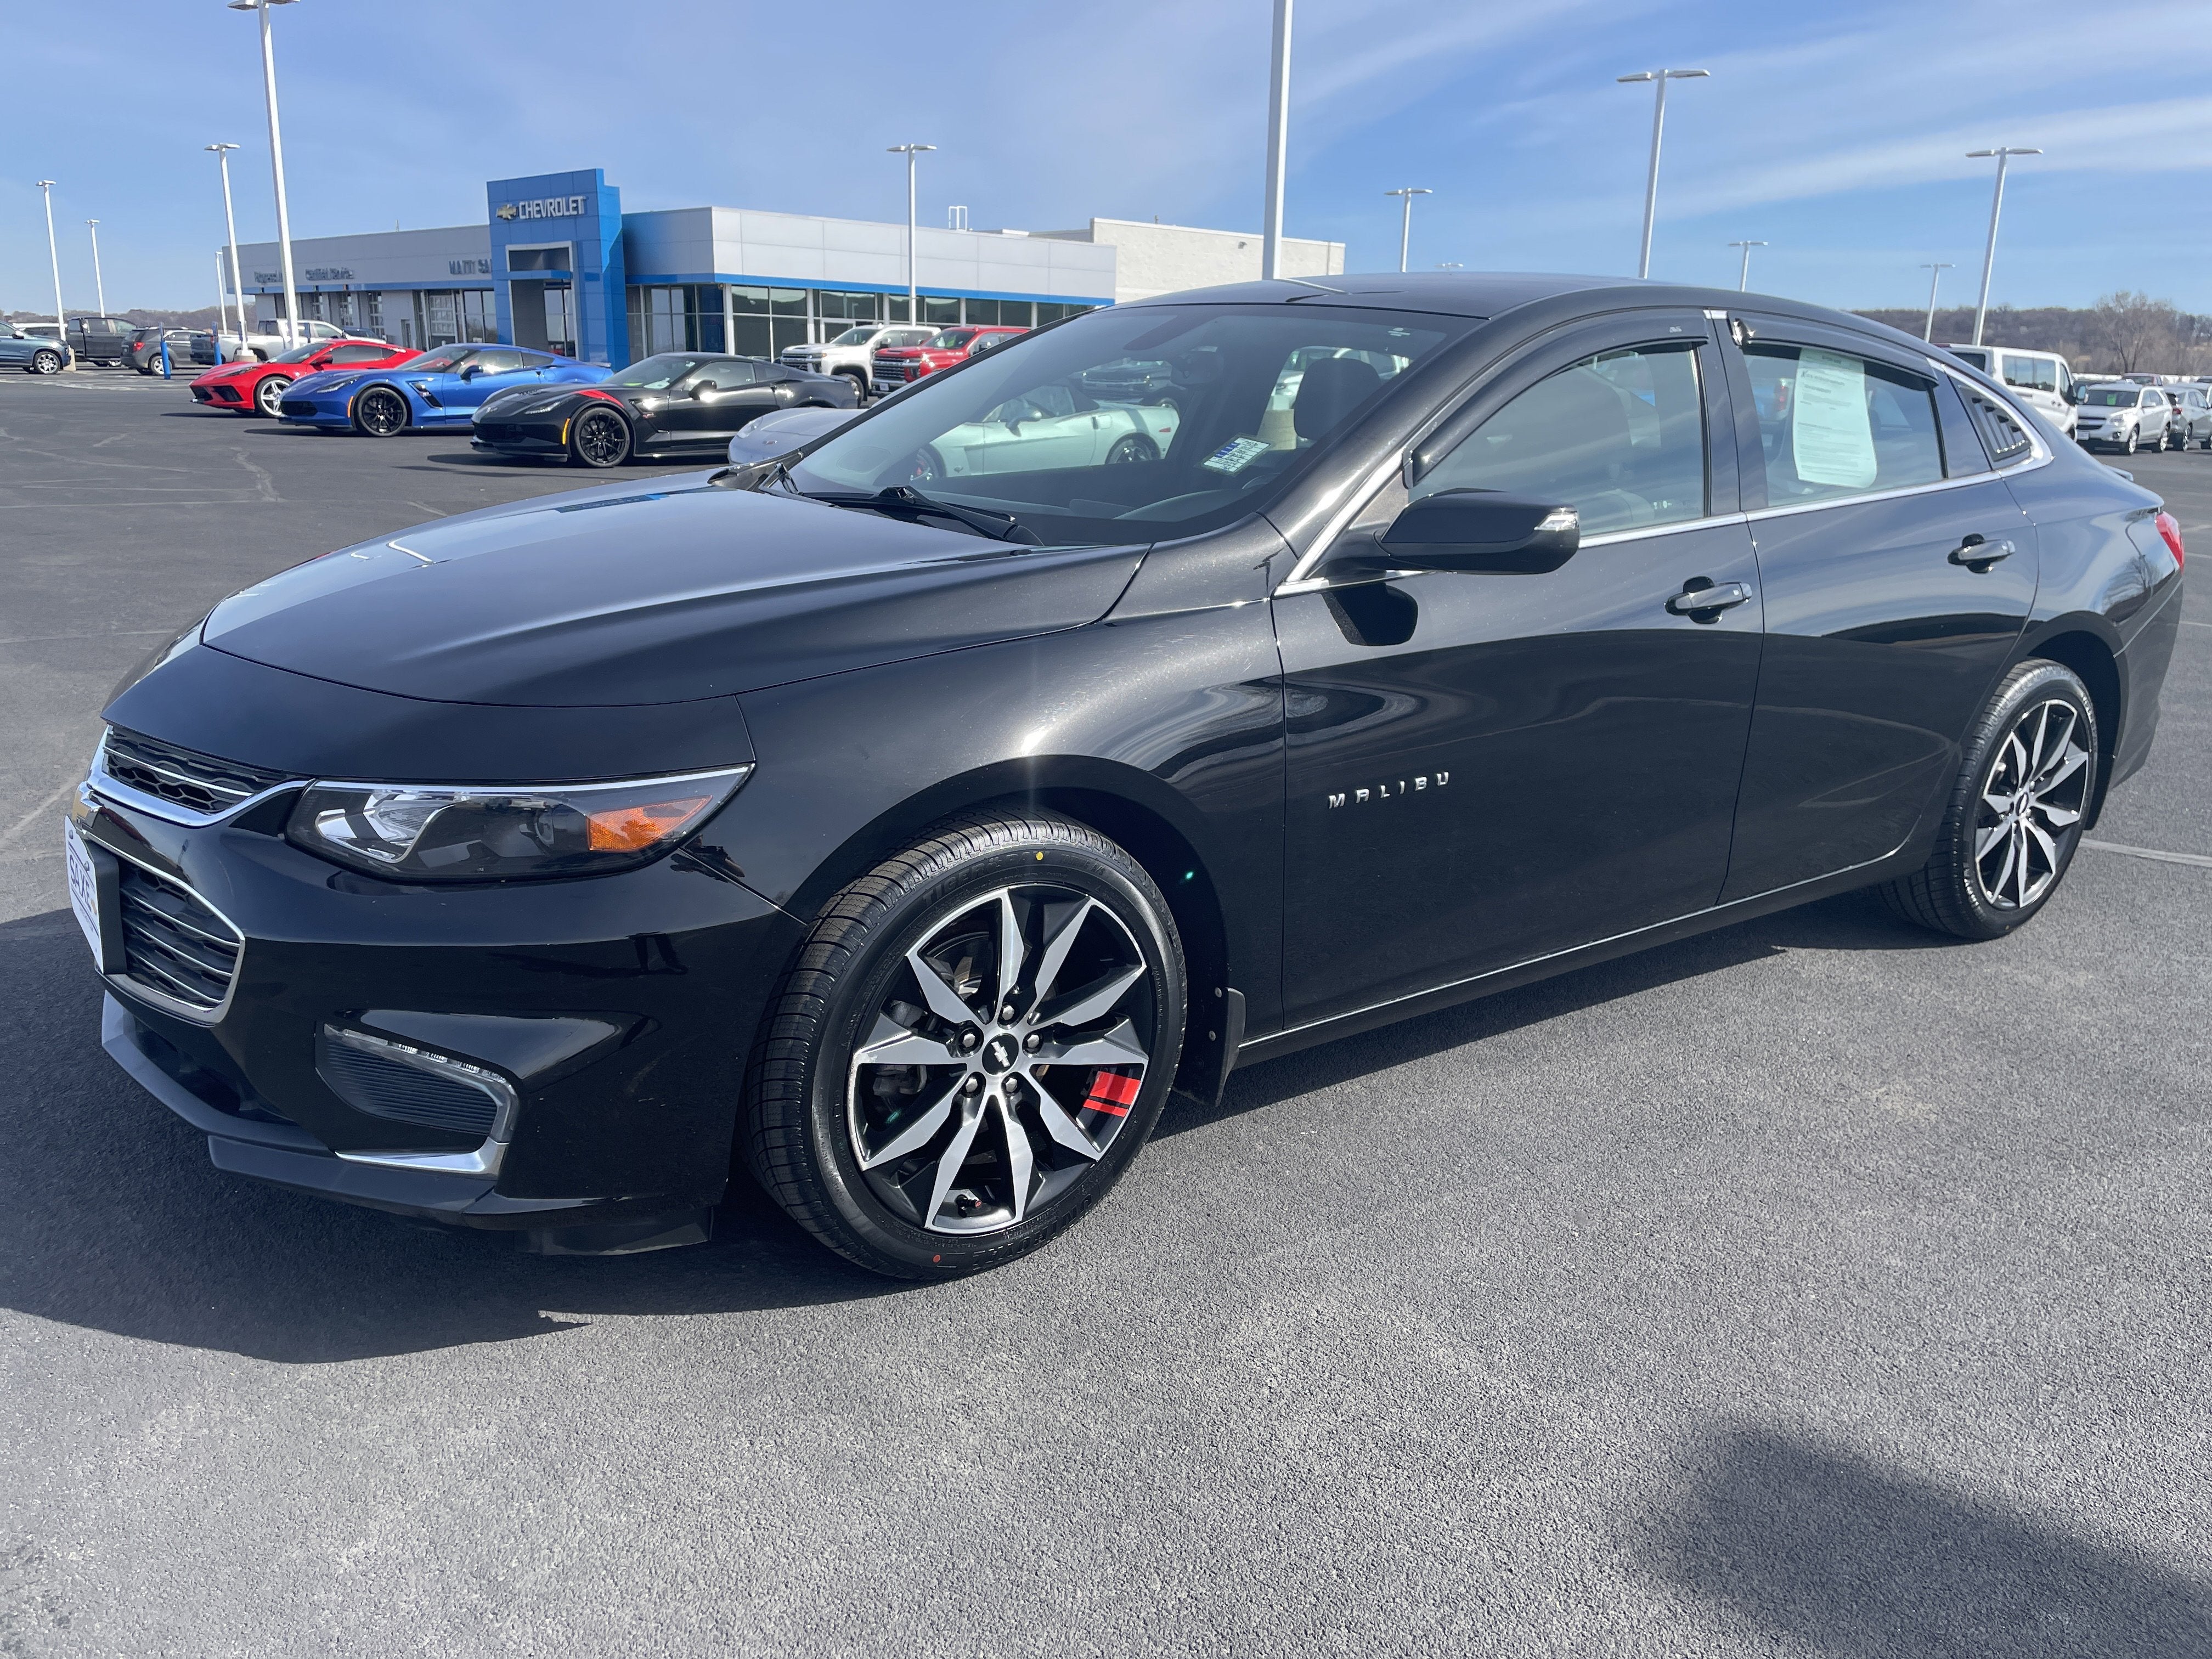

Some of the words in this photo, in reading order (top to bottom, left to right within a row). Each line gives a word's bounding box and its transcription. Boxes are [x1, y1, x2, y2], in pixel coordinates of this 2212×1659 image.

[518, 195, 586, 219] CHEVROLET
[1328, 771, 1449, 809] MALIBU
[69, 854, 92, 913] SAXE
[922, 862, 986, 906] TIGER
